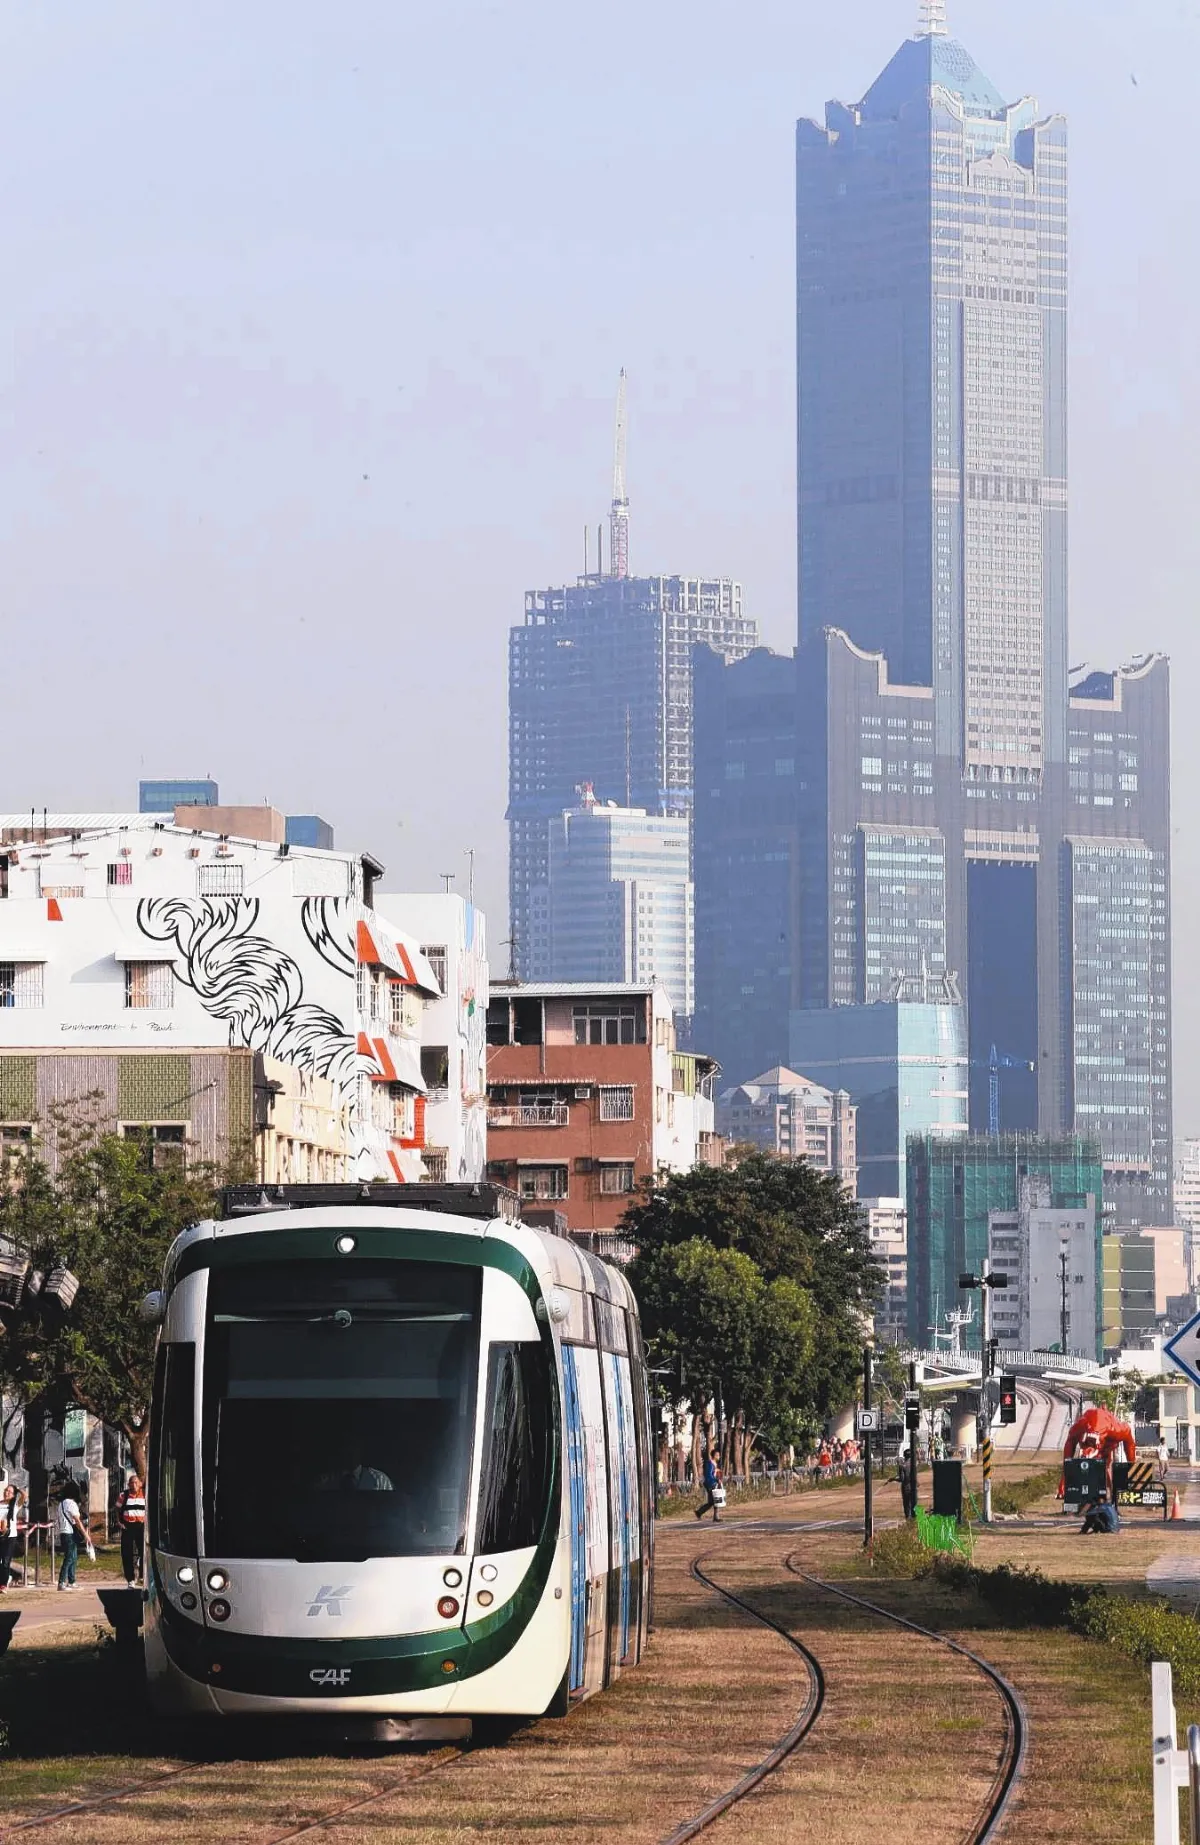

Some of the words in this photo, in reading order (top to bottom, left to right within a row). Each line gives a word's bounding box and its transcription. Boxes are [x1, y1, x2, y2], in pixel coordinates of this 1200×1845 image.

[862, 1413, 873, 1427] D
[305, 1585, 356, 1617] K
[309, 1668, 352, 1686] CAF
